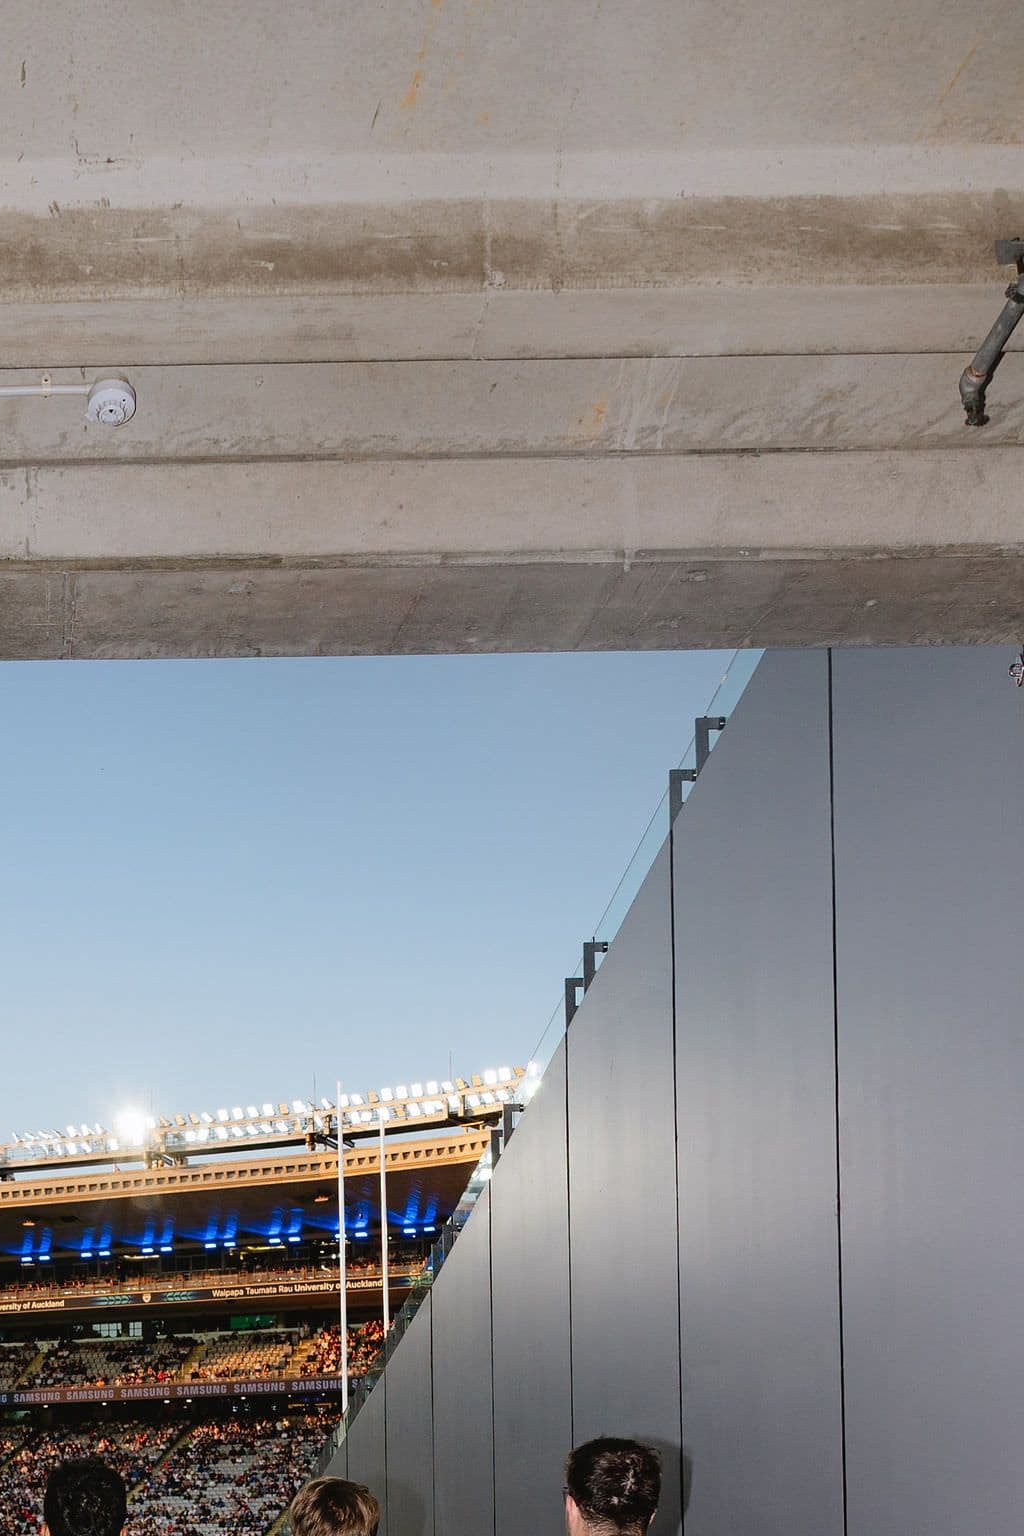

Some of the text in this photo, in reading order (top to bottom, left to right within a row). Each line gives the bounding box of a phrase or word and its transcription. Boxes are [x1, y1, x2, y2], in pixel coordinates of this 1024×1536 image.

[212, 1288, 244, 1298] Waipapa
[245, 1286, 277, 1296] Taumata
[278, 1285, 294, 1293] Rau
[294, 1282, 334, 1293] University
[346, 1279, 384, 1289] Auckland
[22, 1301, 32, 1309] of
[31, 1300, 65, 1309] Auckland
[13, 1391, 61, 1403] SAMSUNG
[66, 1389, 114, 1400] SAMSUNG
[120, 1387, 171, 1398] SAMSUNG
[176, 1384, 228, 1396] SAMSUNG
[233, 1381, 286, 1393] SAMSUNG
